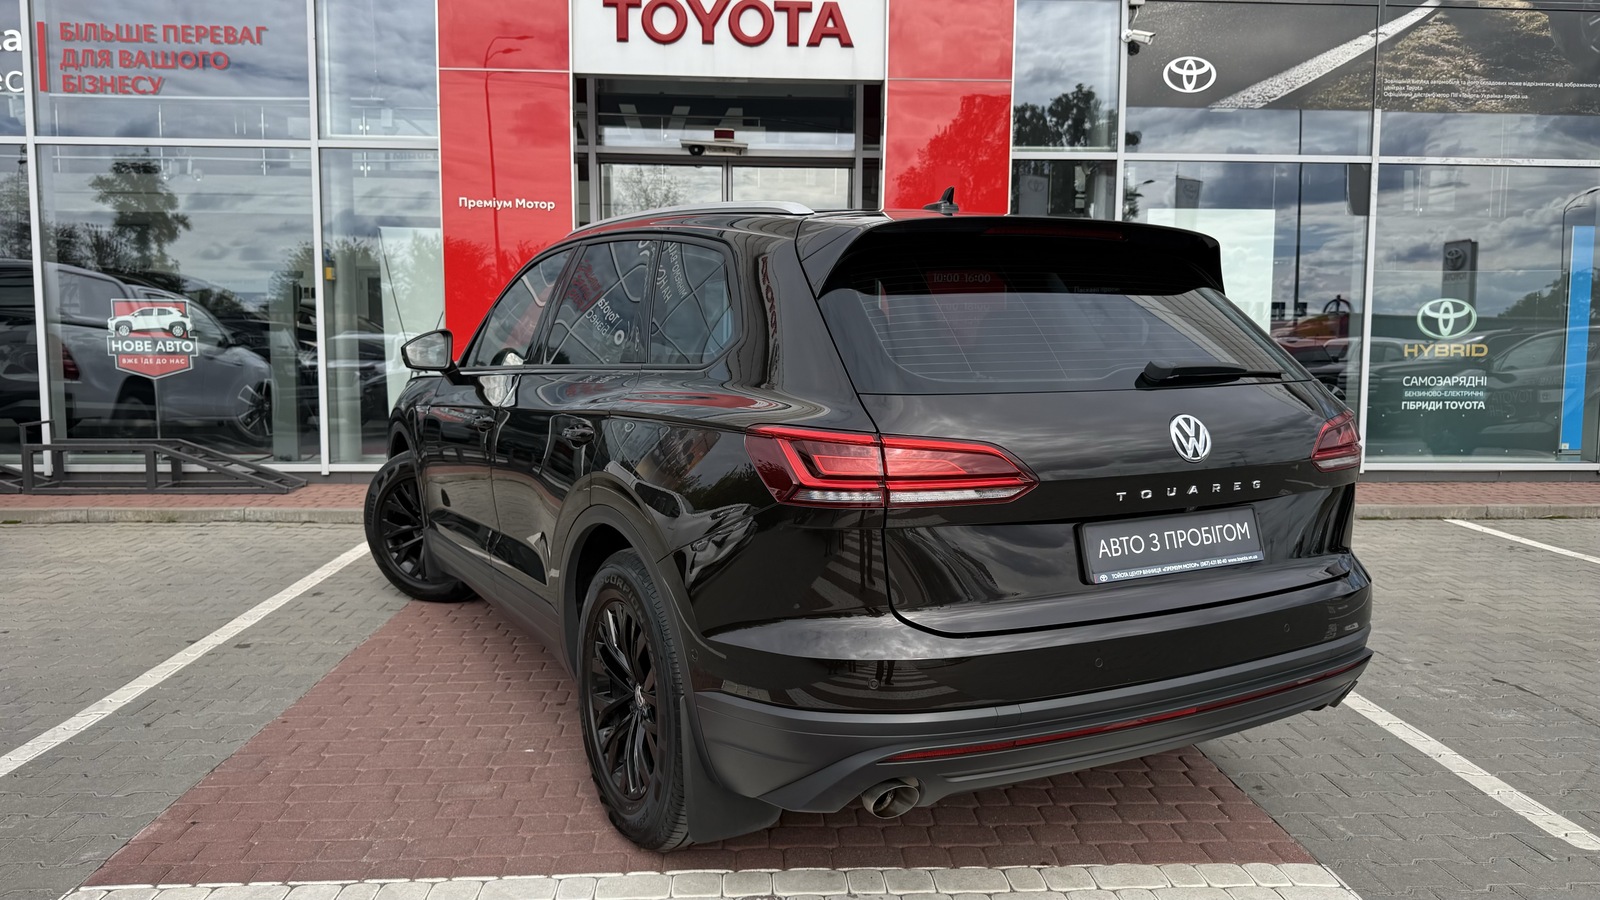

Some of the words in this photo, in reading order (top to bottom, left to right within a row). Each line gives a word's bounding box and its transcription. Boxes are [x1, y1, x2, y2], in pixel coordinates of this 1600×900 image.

[602, 0, 854, 47] TOYOTA
[59, 22, 157, 42] БІЛЬШЕ
[162, 25, 267, 45] ПЕРЕВАГ
[59, 48, 111, 70] ДЛЯ
[118, 50, 229, 70] ВАШОГО
[62, 74, 165, 95] БІЗНЕСУ
[458, 197, 512, 210] Преміум
[516, 198, 556, 211] Мотор
[933, 272, 960, 283] 10:00
[964, 272, 991, 283] 16:00
[111, 340, 152, 352] НОВЕ
[155, 340, 194, 352] АВТО
[1404, 343, 1489, 358] HYBRID
[1402, 376, 1488, 388] САМОЗАРЯДНІ
[1402, 401, 1442, 411] ГІБРИДИ
[1444, 401, 1486, 410] TOYOTA
[1116, 480, 1261, 502] TOUAREG
[1098, 535, 1145, 558] АВТО
[1149, 533, 1160, 552] З
[1164, 522, 1250, 550] ПРОБІГОМ
